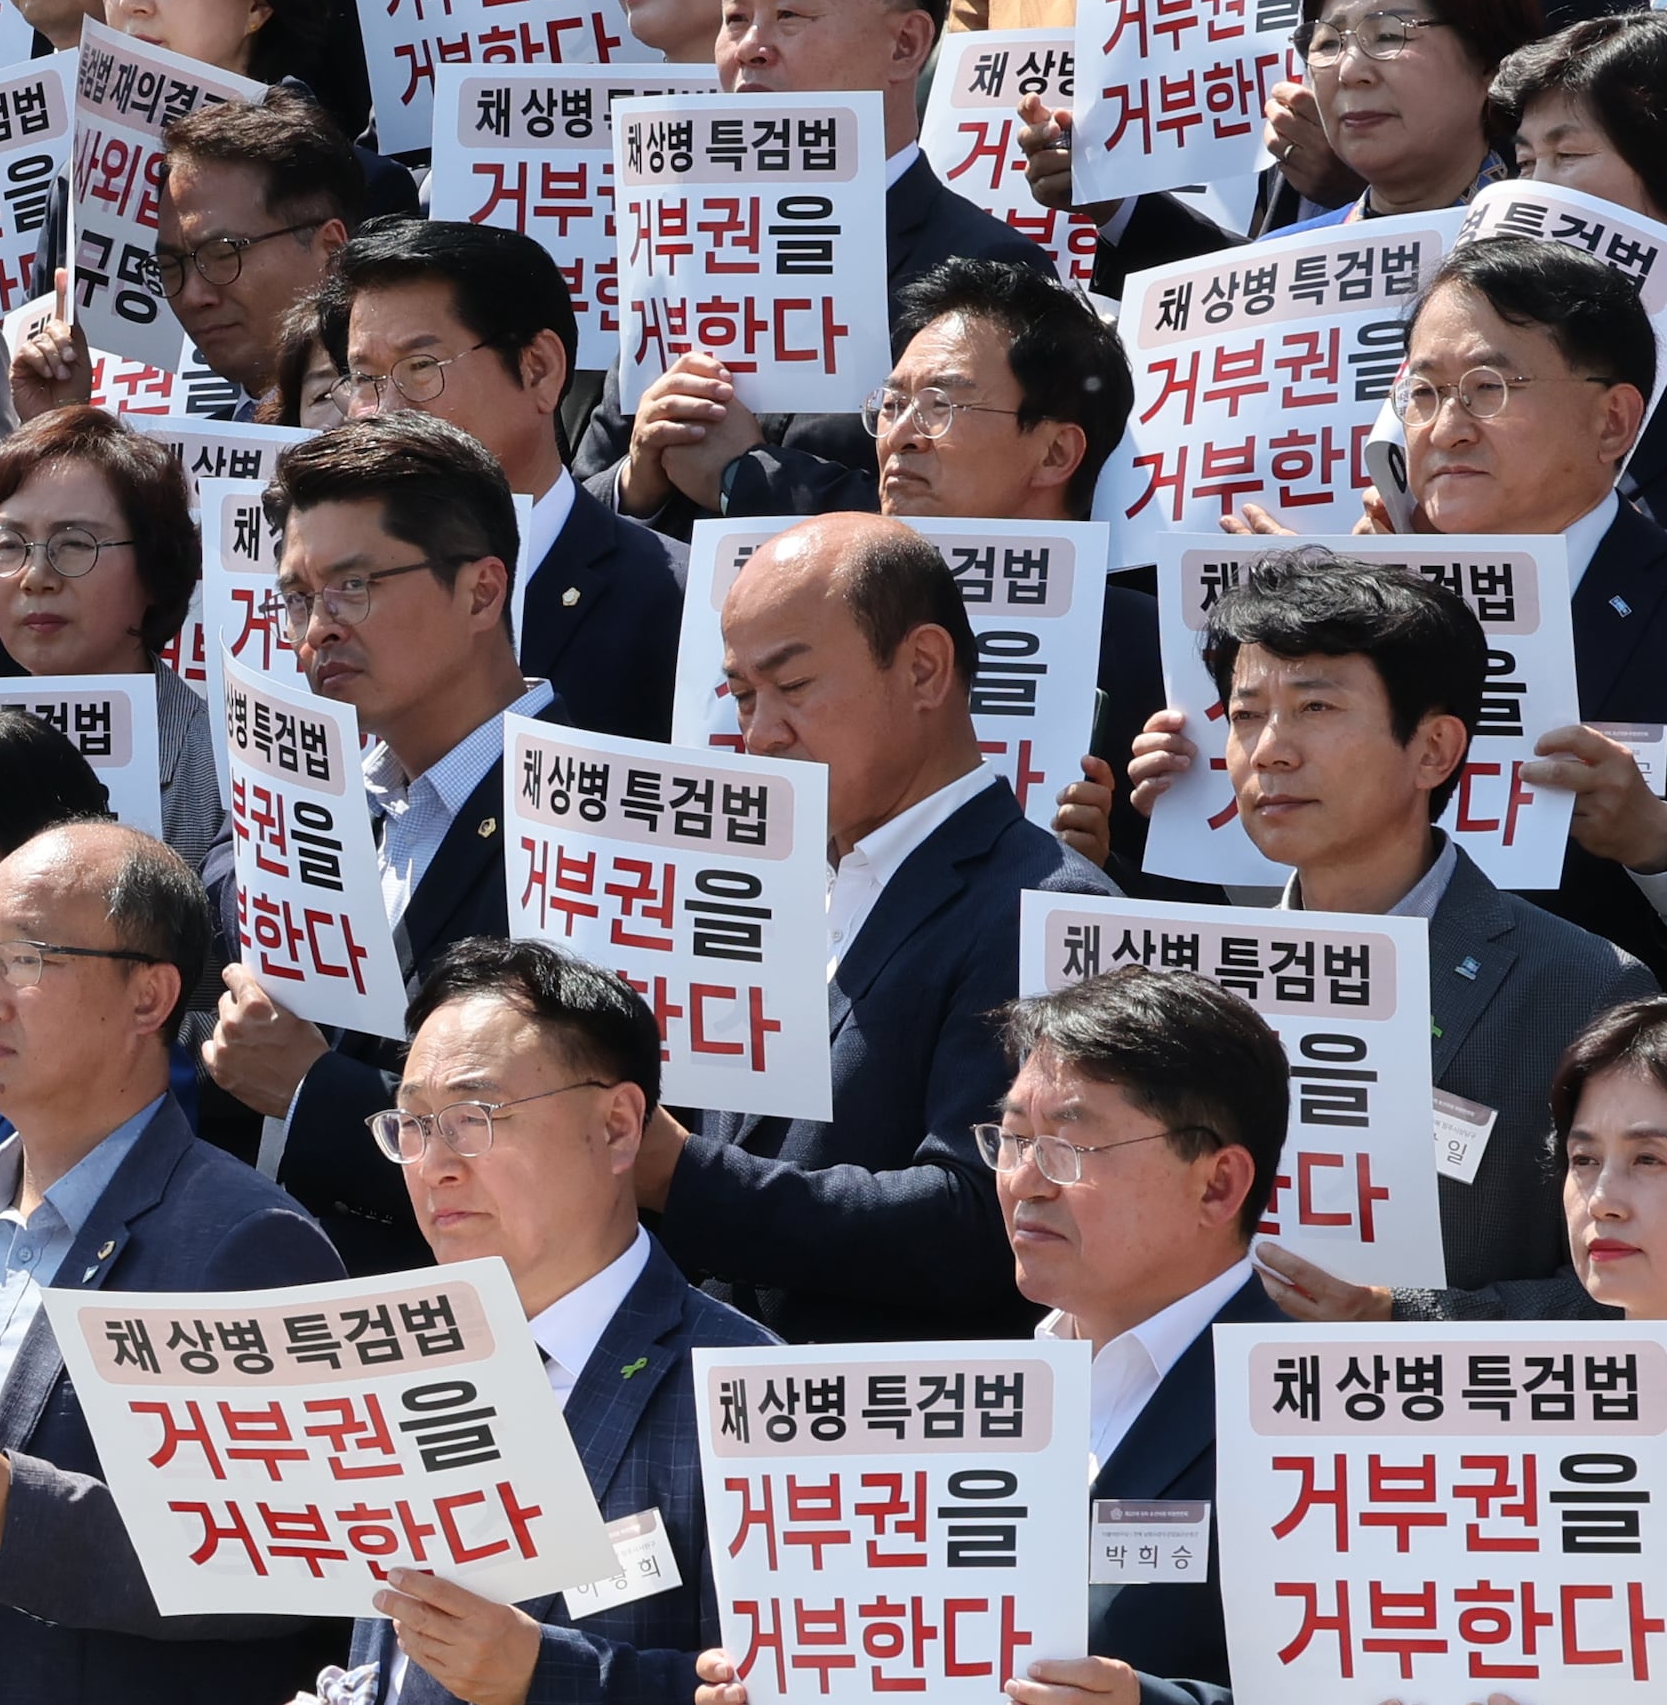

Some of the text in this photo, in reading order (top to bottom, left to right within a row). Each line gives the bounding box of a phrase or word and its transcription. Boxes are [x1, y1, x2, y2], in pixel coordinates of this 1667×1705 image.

[476, 89, 593, 140] 채 상병
[628, 117, 837, 175] 채 상병 특검법
[629, 195, 841, 277] 거부권을
[1153, 241, 1421, 332] 채 상병 특검법
[632, 294, 848, 375] 거부한다
[1139, 320, 1408, 427] 거부권을
[252, 699, 330, 781] 특검법
[522, 748, 768, 846] 채 상병 특검법
[520, 835, 772, 963] 거부권을
[1214, 935, 1371, 1007] 특검법
[104, 1294, 466, 1375] 채 상병 특검법
[128, 1380, 502, 1481] 거부권을
[720, 1370, 1027, 1445] 채 상병 특검법
[1271, 1350, 1641, 1424] 채 상병 특검법
[170, 1481, 543, 1581] 거부한다
[725, 1468, 1028, 1572] 거부권을
[1269, 1450, 1655, 1556] 거부권을
[731, 1593, 1033, 1698] 거부한다
[1275, 1577, 1666, 1684] 거부한다
